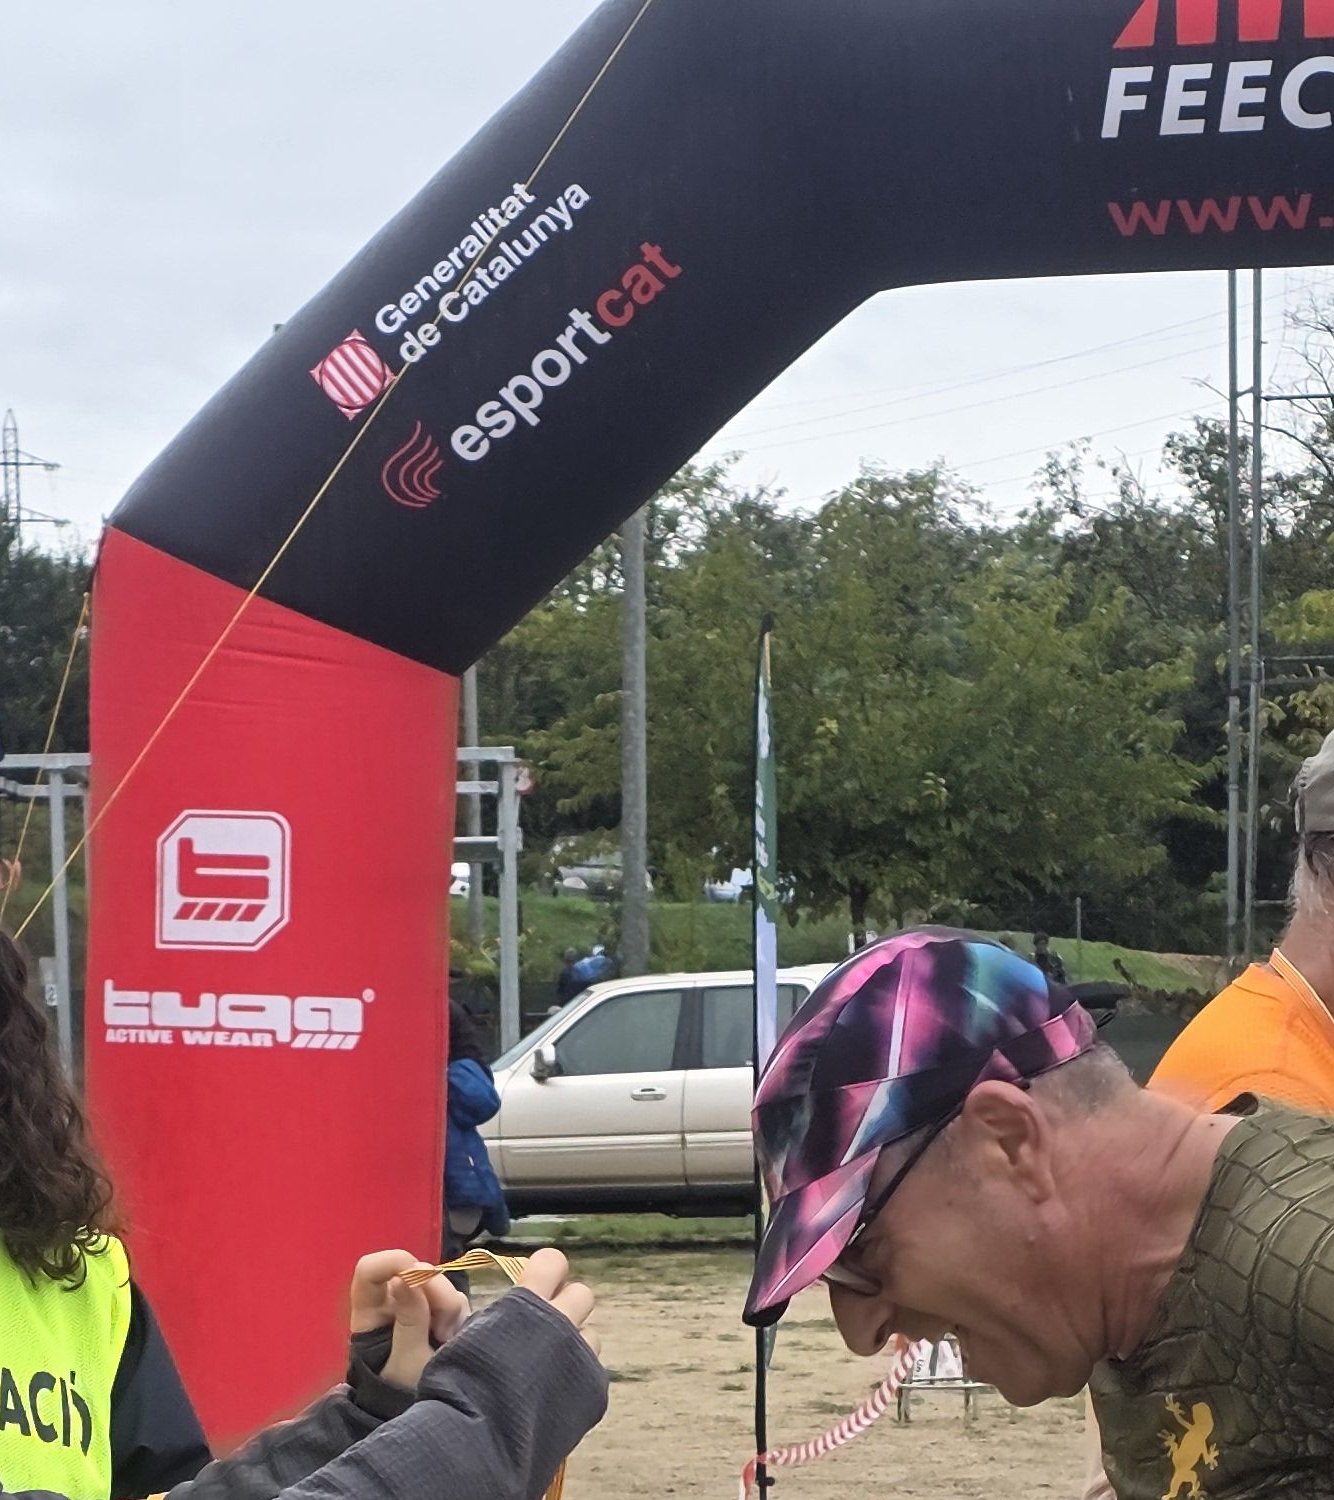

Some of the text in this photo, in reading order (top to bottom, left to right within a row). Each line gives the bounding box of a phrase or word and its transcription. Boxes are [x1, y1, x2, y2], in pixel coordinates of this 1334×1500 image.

[375, 182, 538, 334] Generalitat
[399, 182, 592, 364] de Catalunya
[450, 240, 683, 462] esportcat
[105, 1028, 273, 1048] ACTIVE WEAR
